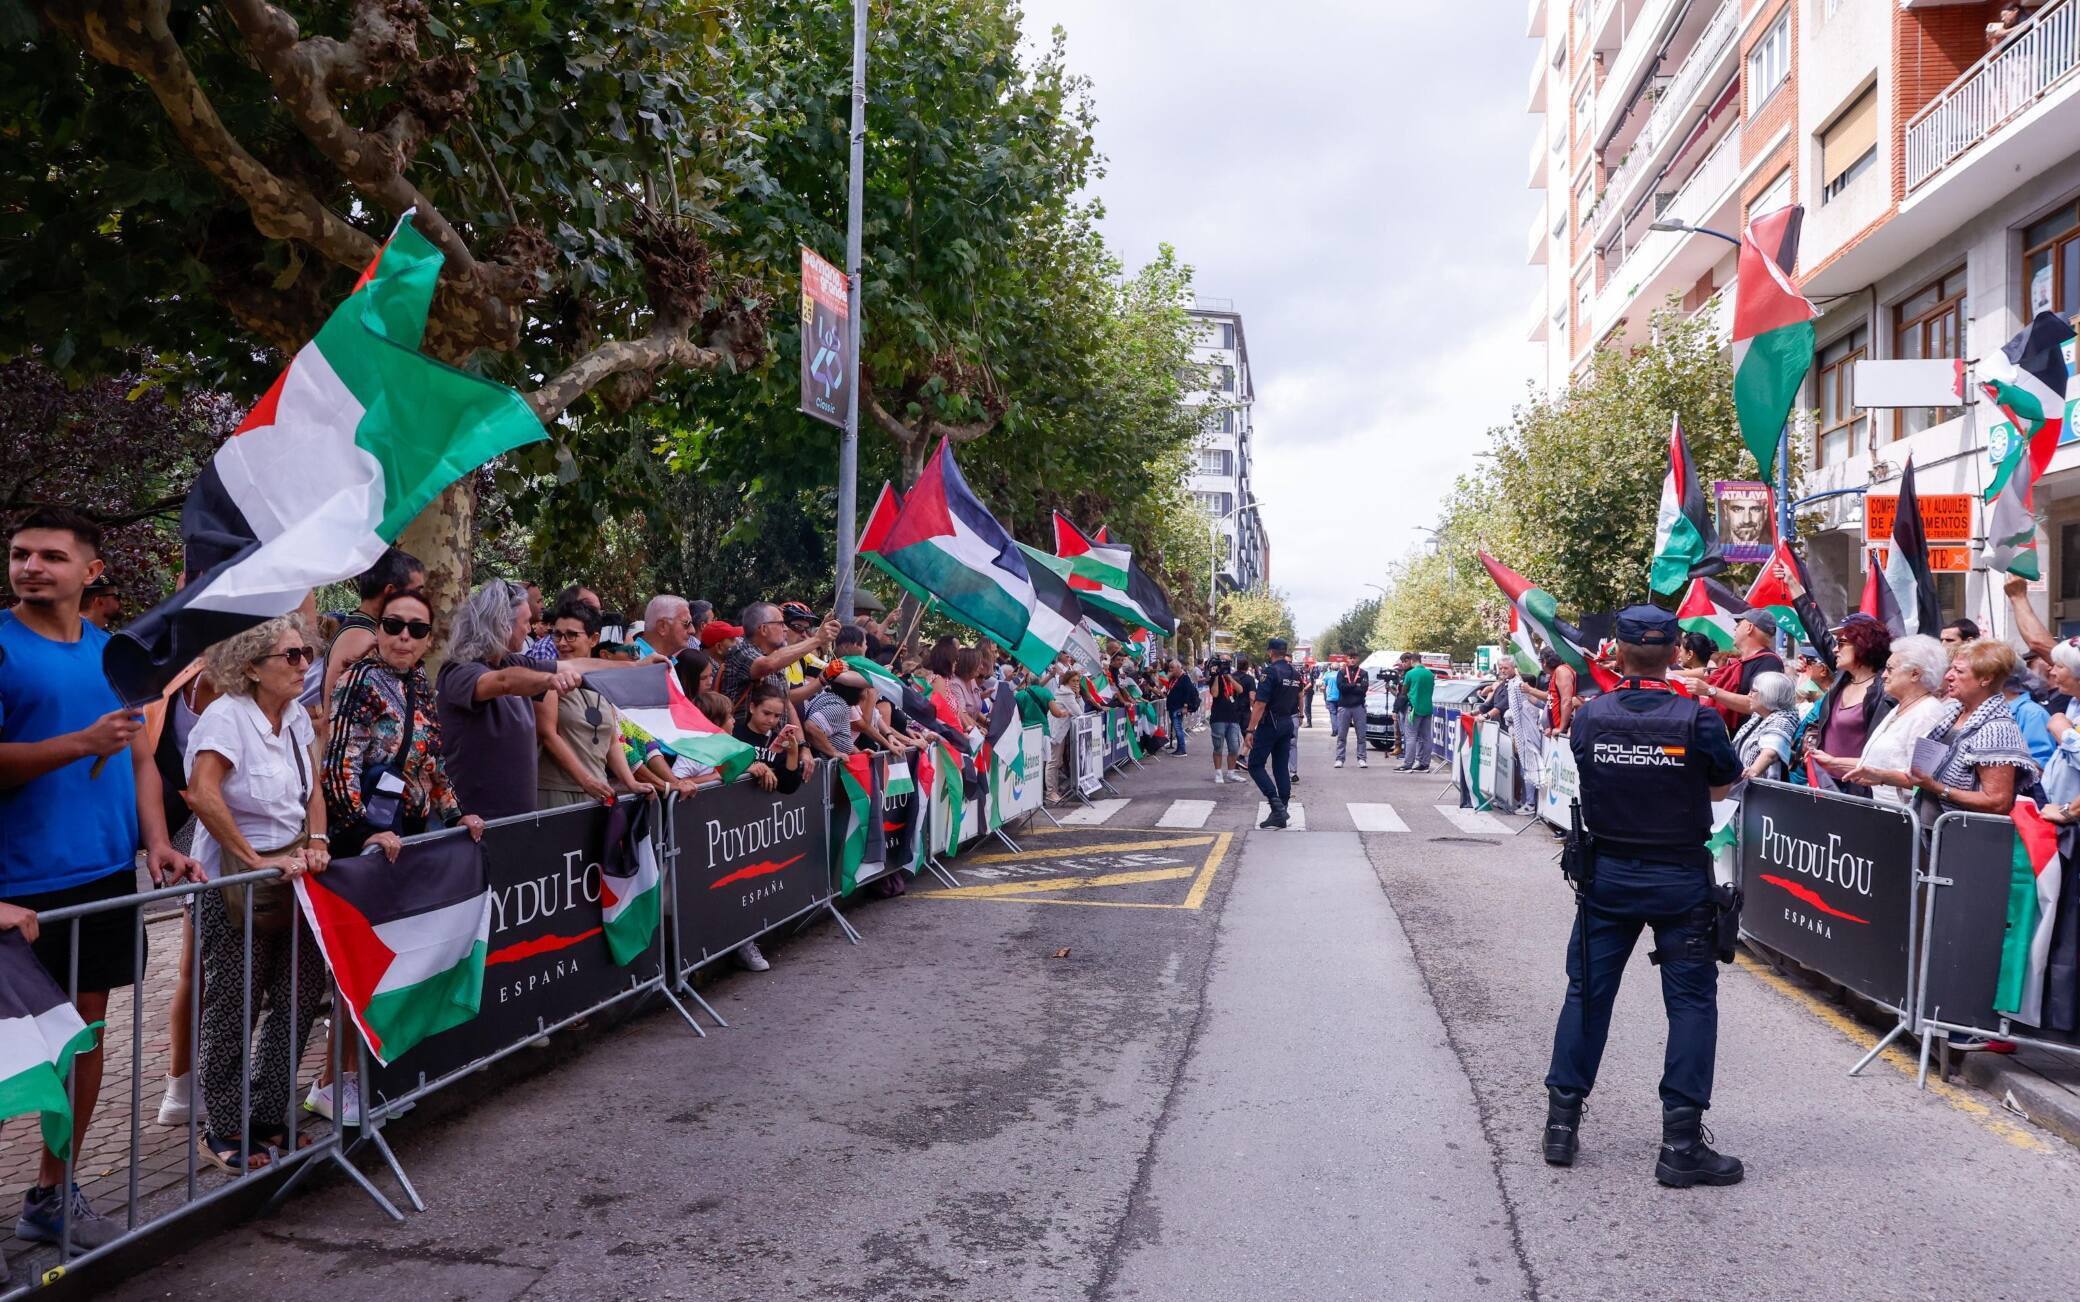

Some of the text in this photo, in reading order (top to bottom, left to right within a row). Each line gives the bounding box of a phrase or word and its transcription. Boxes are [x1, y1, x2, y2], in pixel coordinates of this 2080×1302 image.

[815, 397, 836, 414] Classic
[1721, 490, 1768, 500] ATALAYA
[1927, 499, 1932, 512] Y
[1934, 498, 1968, 513] ALQUILER
[1871, 516, 1884, 529] DE
[1066, 641, 1091, 668] LIBRE
[1594, 743, 1665, 756] POLICIA
[1594, 753, 1685, 767] NACIONAL
[491, 849, 602, 934] YDUFO
[742, 880, 784, 908] ESPAÑA
[1784, 908, 1832, 939] ESPAÑA
[500, 958, 579, 1004] ESPAÑA
